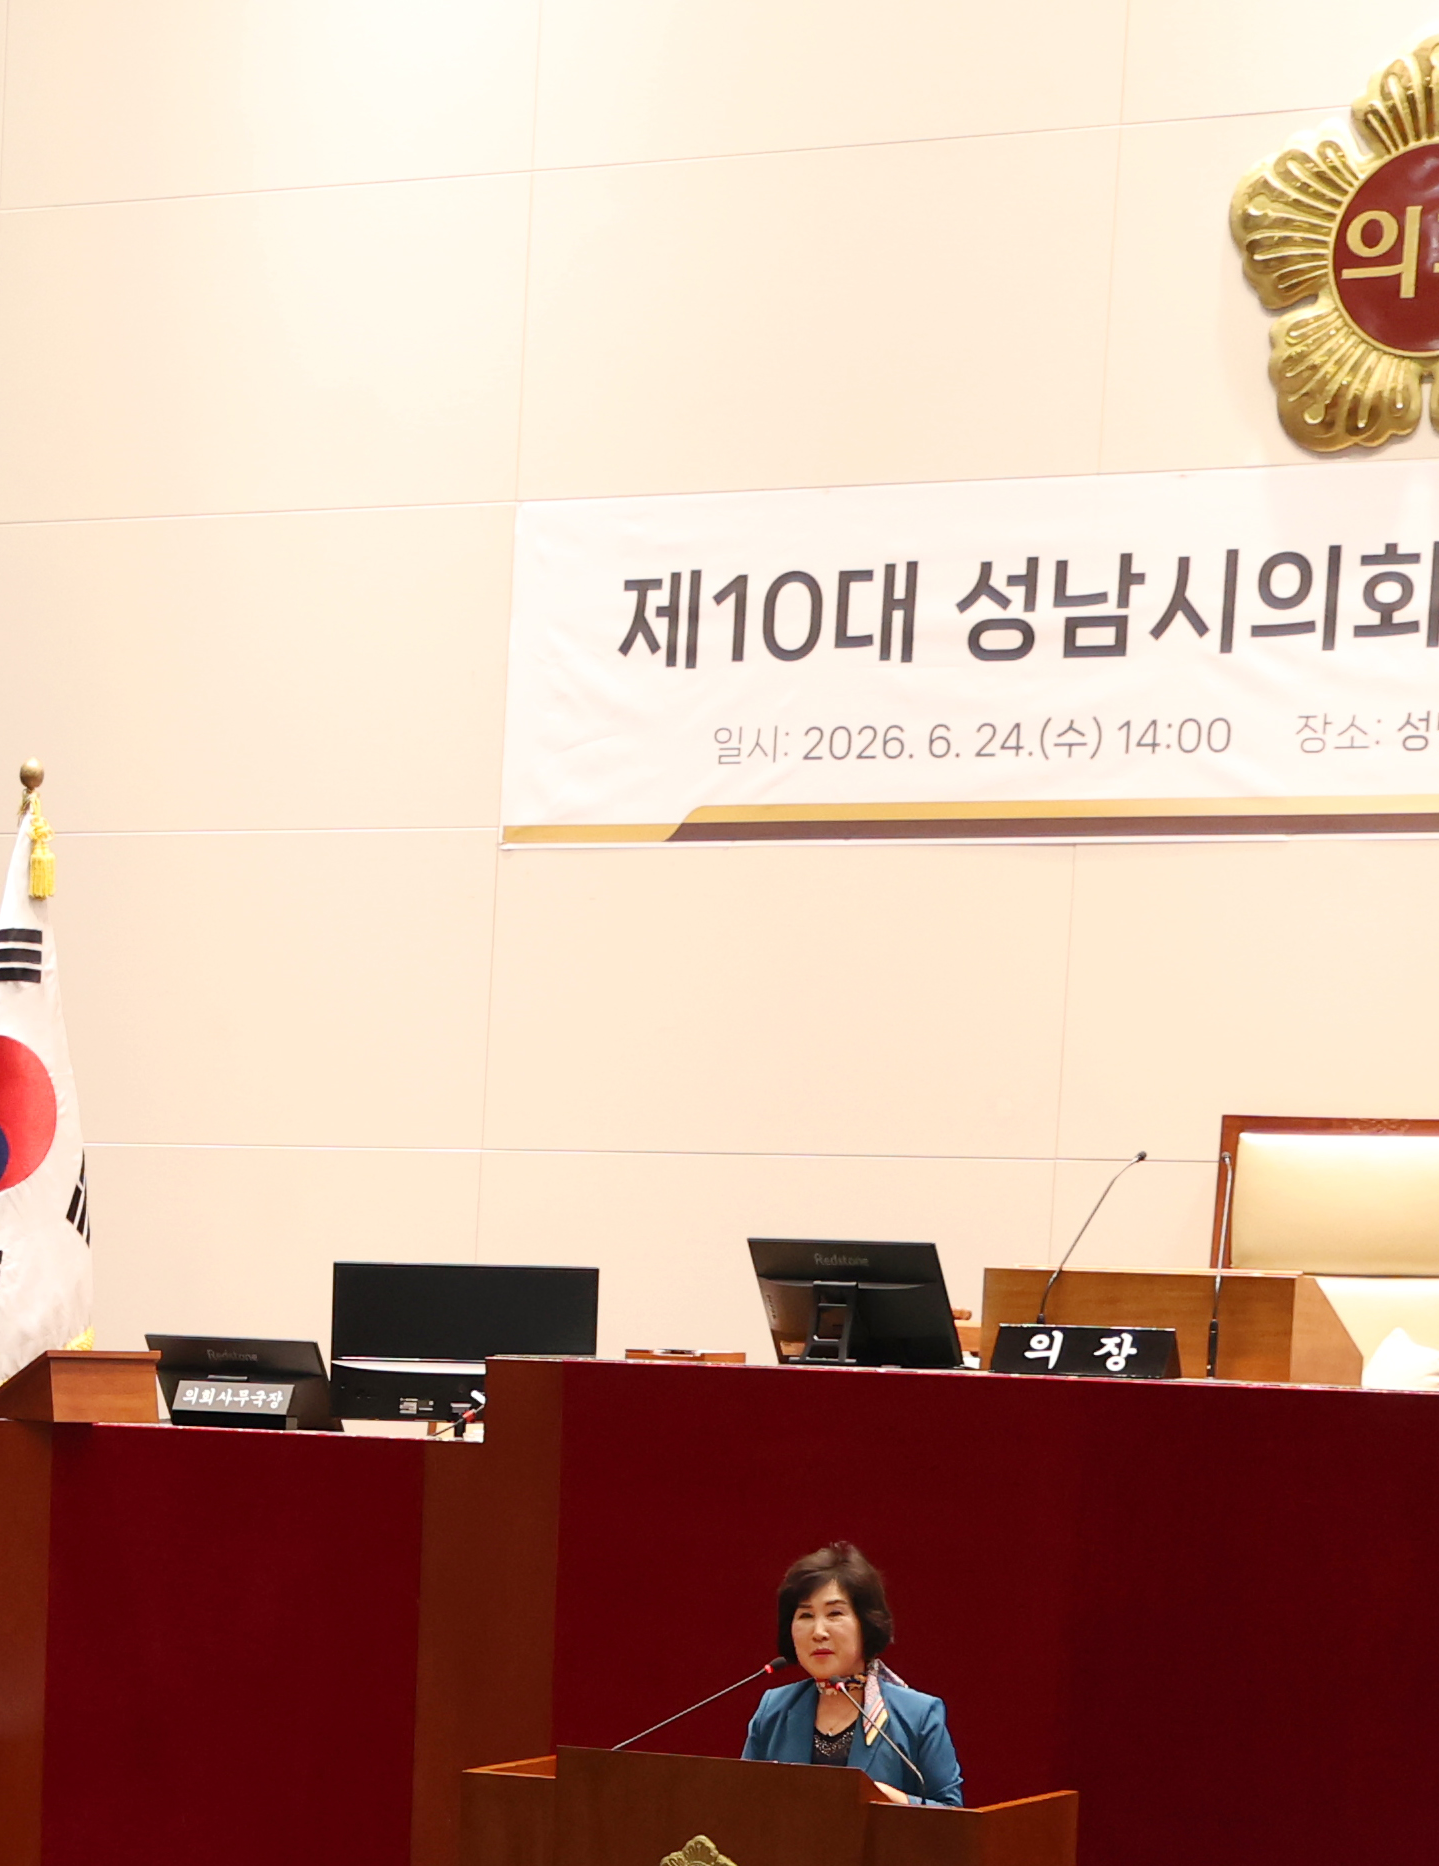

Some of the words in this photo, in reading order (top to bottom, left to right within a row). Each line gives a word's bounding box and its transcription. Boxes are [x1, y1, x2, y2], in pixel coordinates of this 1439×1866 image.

[617, 560, 919, 670] 제10대
[713, 725, 791, 767] 일시:
[802, 724, 914, 762] 2026.
[927, 723, 962, 760] 6.
[974, 716, 1102, 762] 24.(수)
[1117, 716, 1231, 757] 14:00
[1295, 713, 1381, 754] 장소:
[1024, 1330, 1137, 1371] 의장
[183, 1387, 283, 1409] 의회사무국장
